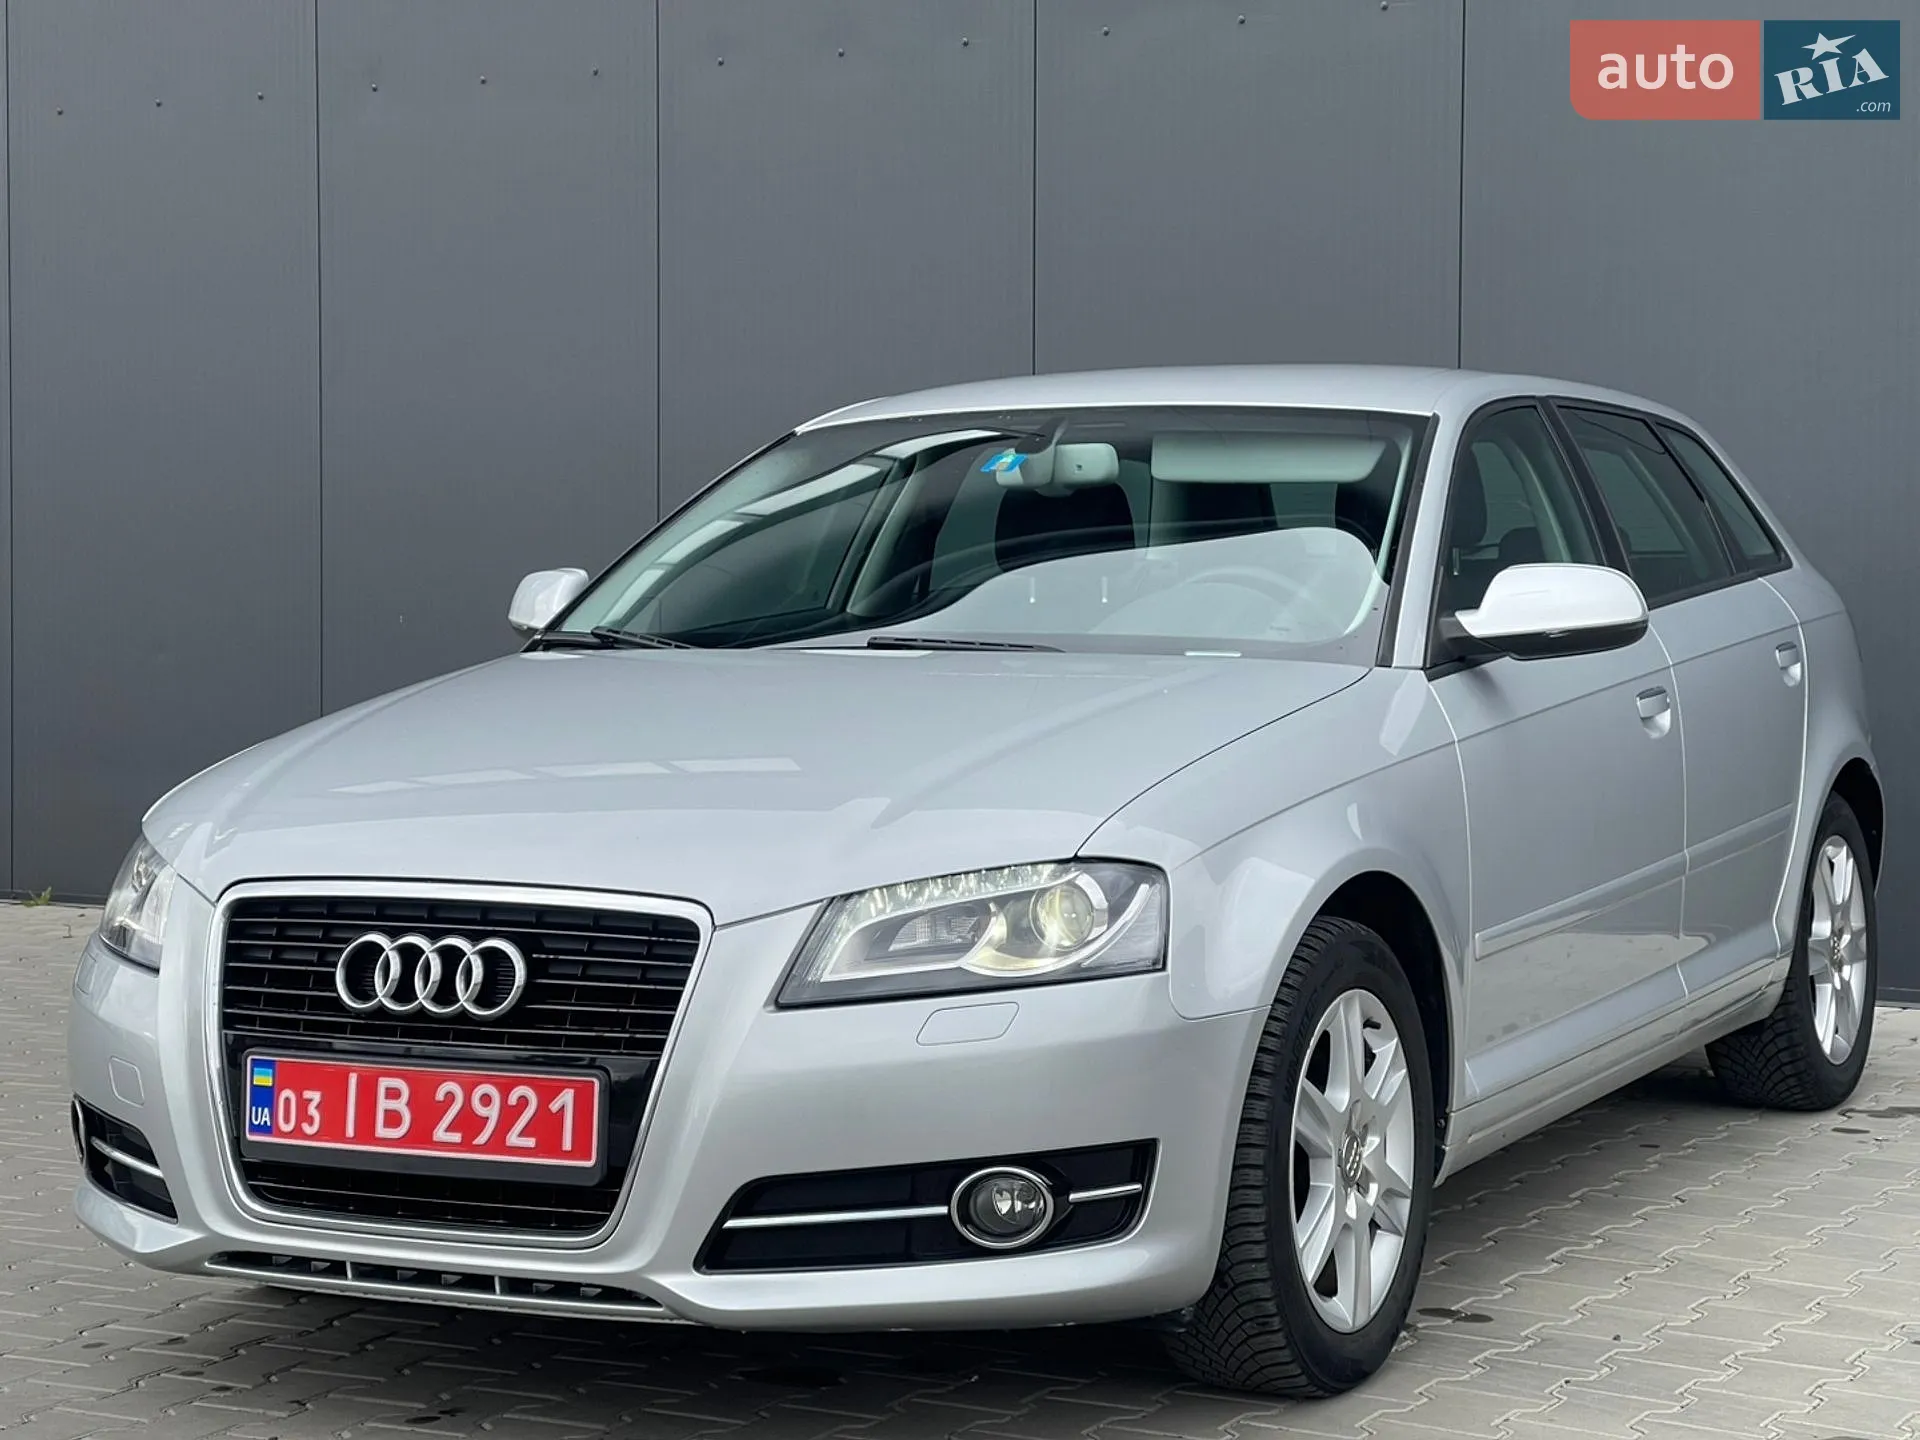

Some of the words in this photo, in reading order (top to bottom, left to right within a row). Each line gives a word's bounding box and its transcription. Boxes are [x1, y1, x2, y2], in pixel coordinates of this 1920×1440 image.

[250, 1106, 271, 1127] UA
[276, 1087, 323, 1136] 03
[432, 1080, 575, 1152] 2921
